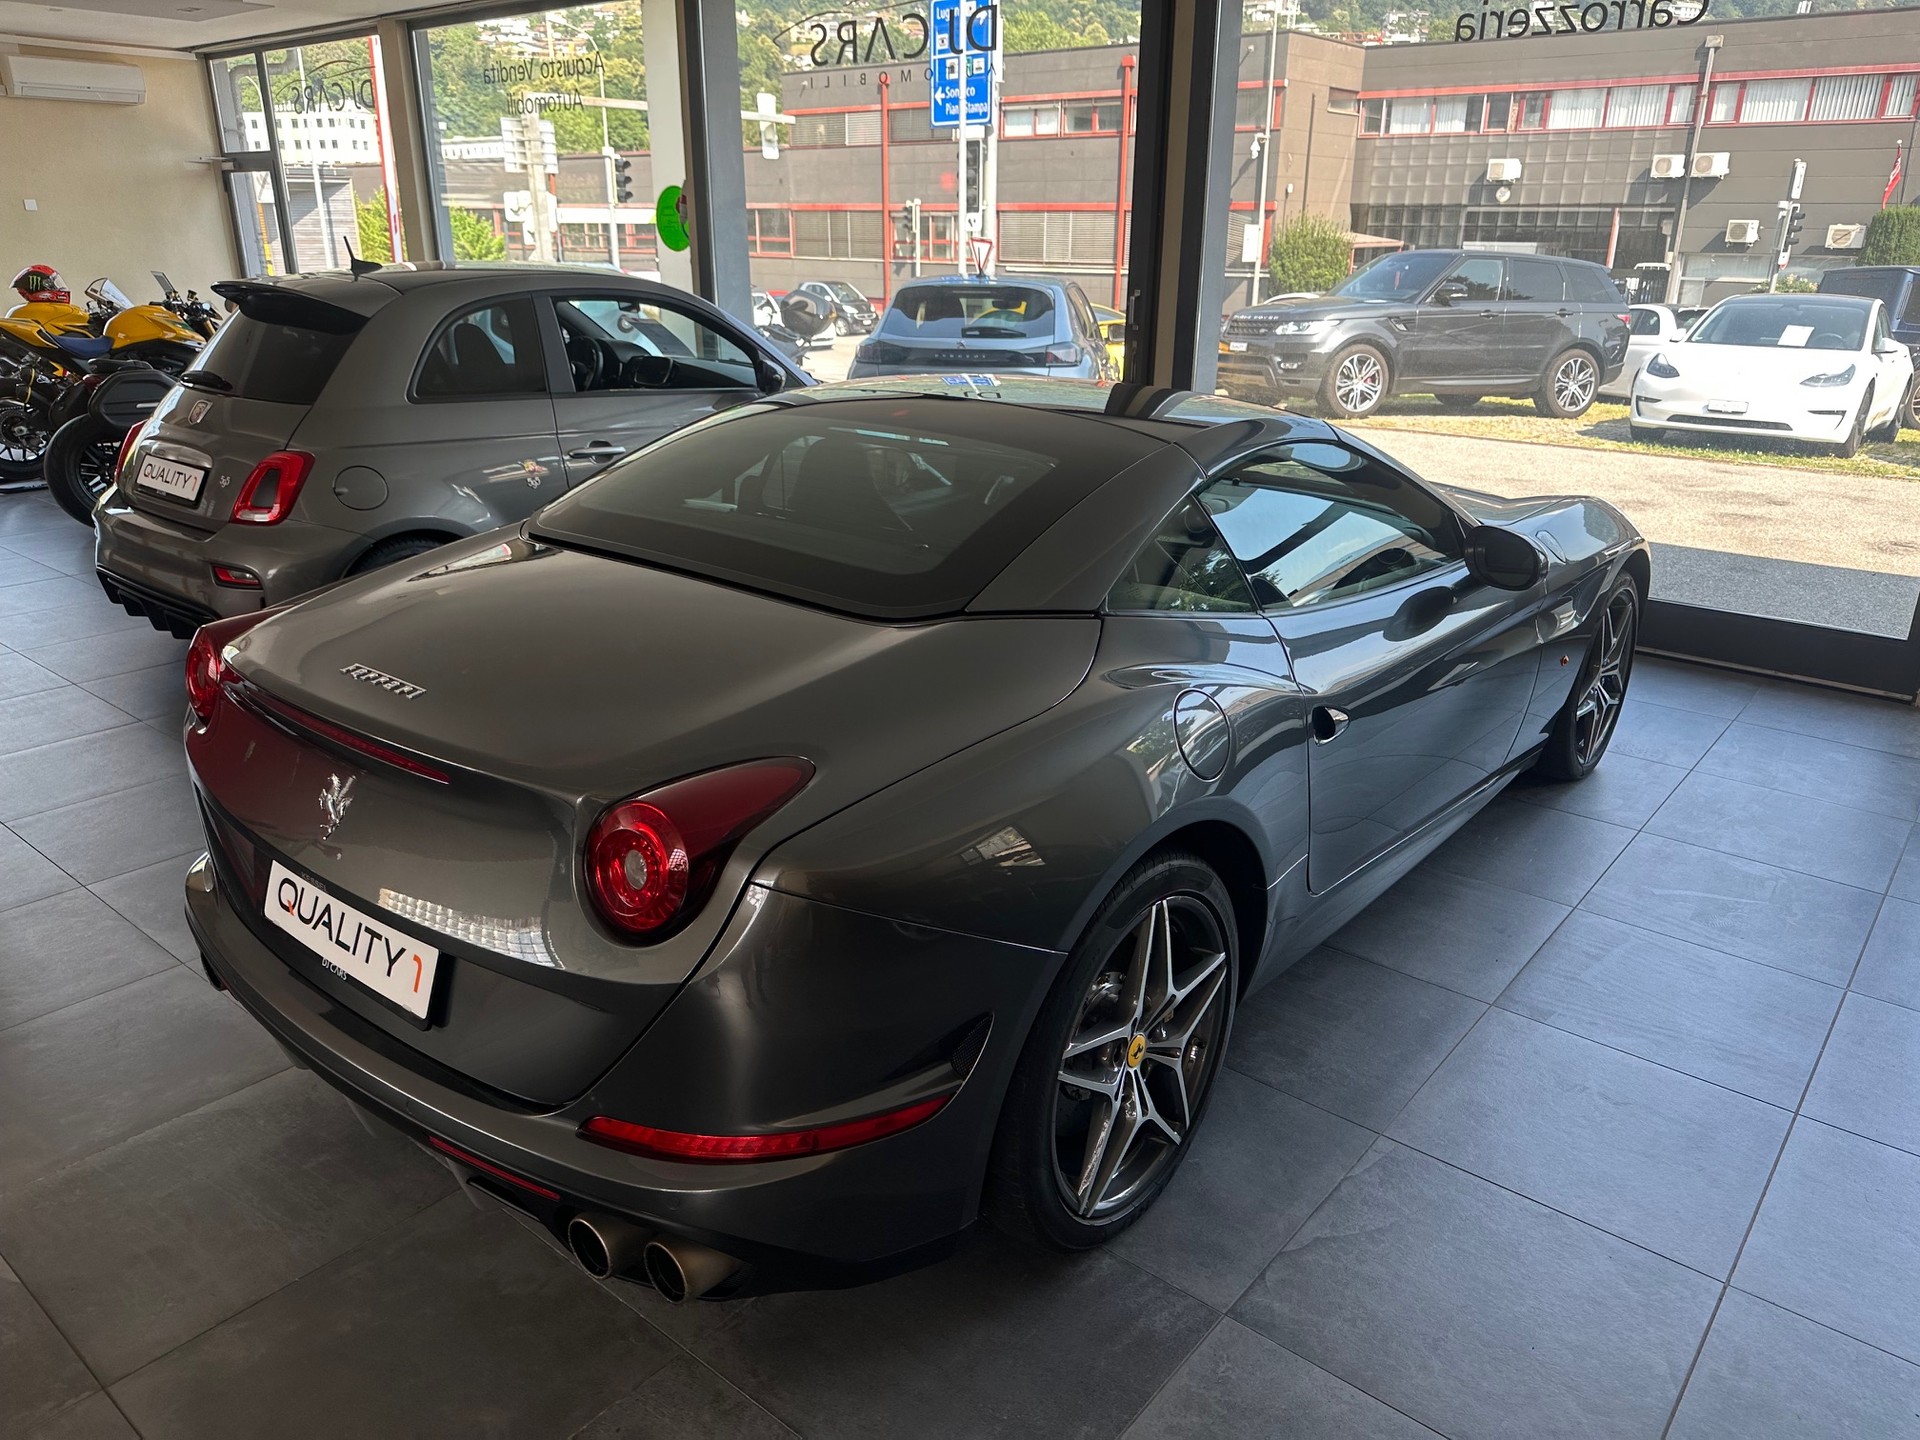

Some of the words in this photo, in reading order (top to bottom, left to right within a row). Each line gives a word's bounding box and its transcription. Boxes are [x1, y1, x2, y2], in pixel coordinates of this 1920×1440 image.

[143, 463, 192, 489] QUALITY
[278, 877, 407, 978] QUALITY
[329, 963, 348, 981] CARS
